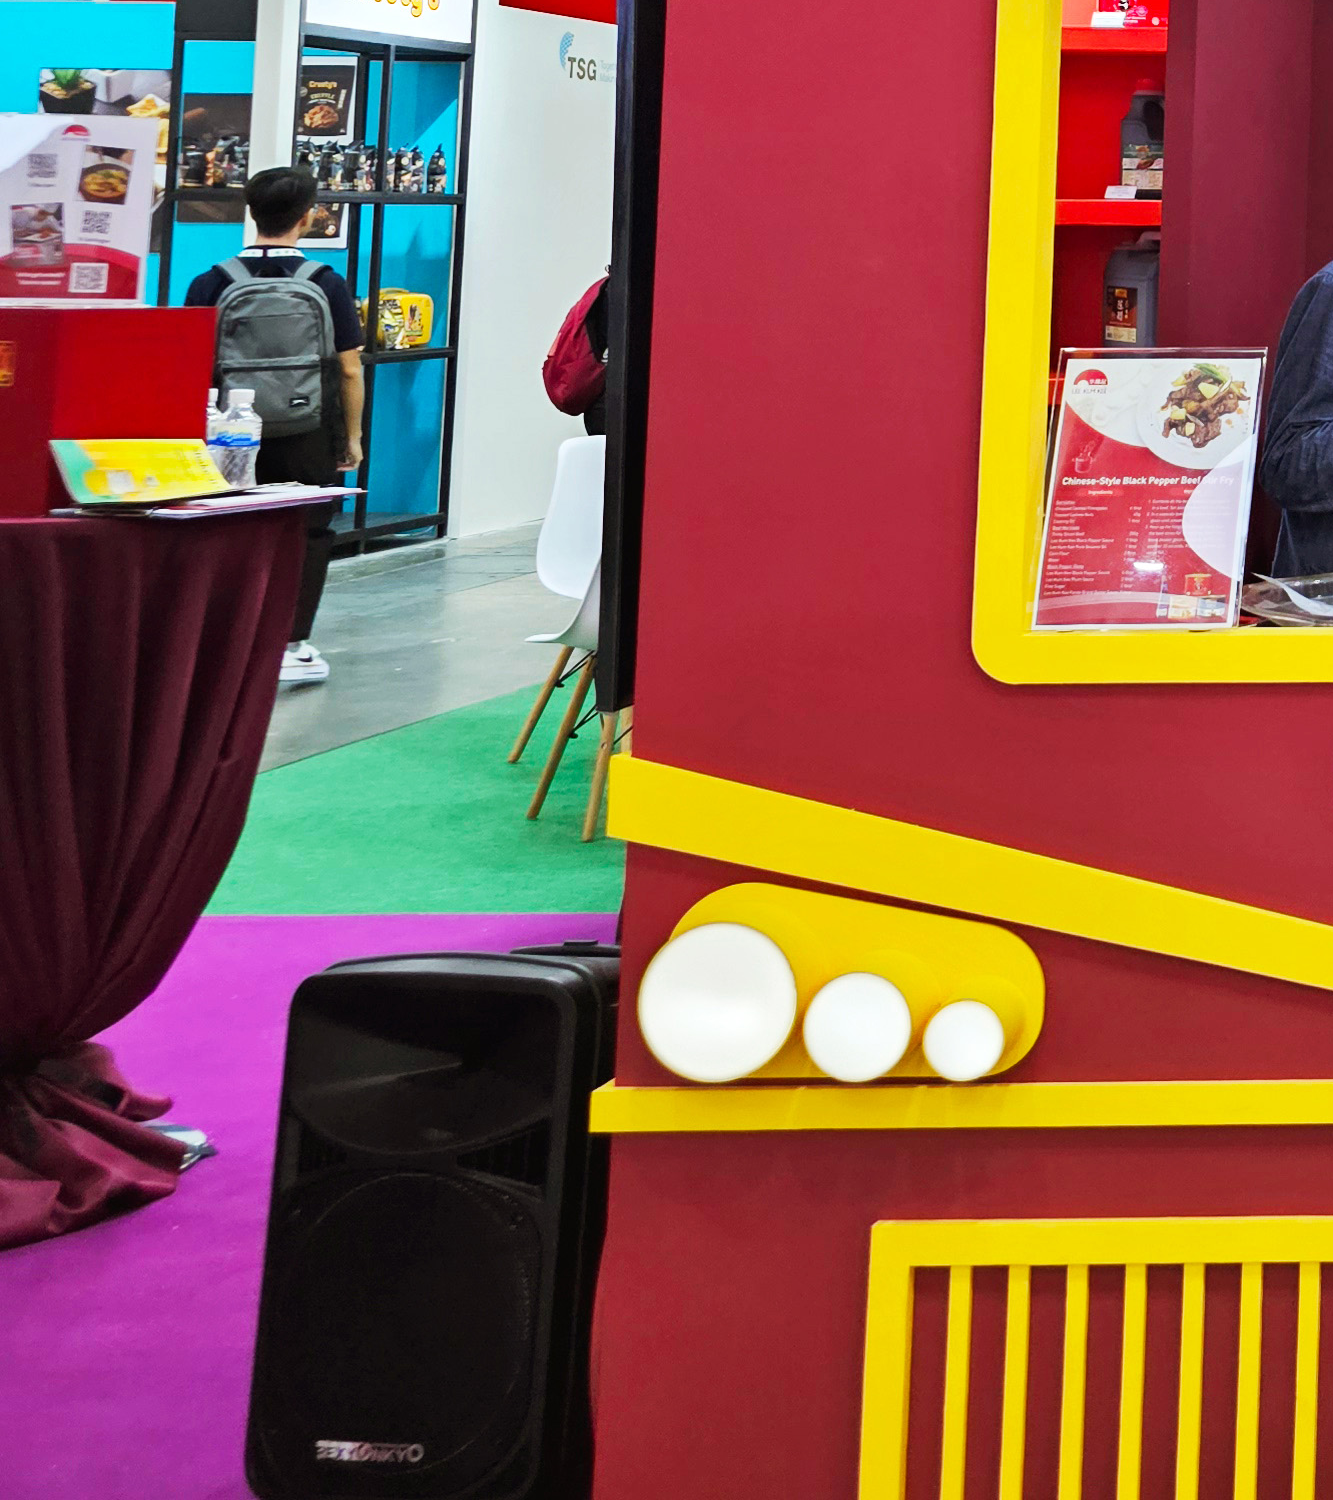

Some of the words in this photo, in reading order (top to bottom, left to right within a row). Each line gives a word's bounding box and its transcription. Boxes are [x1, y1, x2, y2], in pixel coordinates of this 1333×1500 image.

[567, 56, 597, 81] TSG
[1062, 476, 1121, 486] Chinese-Style
[1123, 476, 1147, 485] Black
[1148, 476, 1179, 486] Pepper
[1181, 476, 1201, 484] Beef
